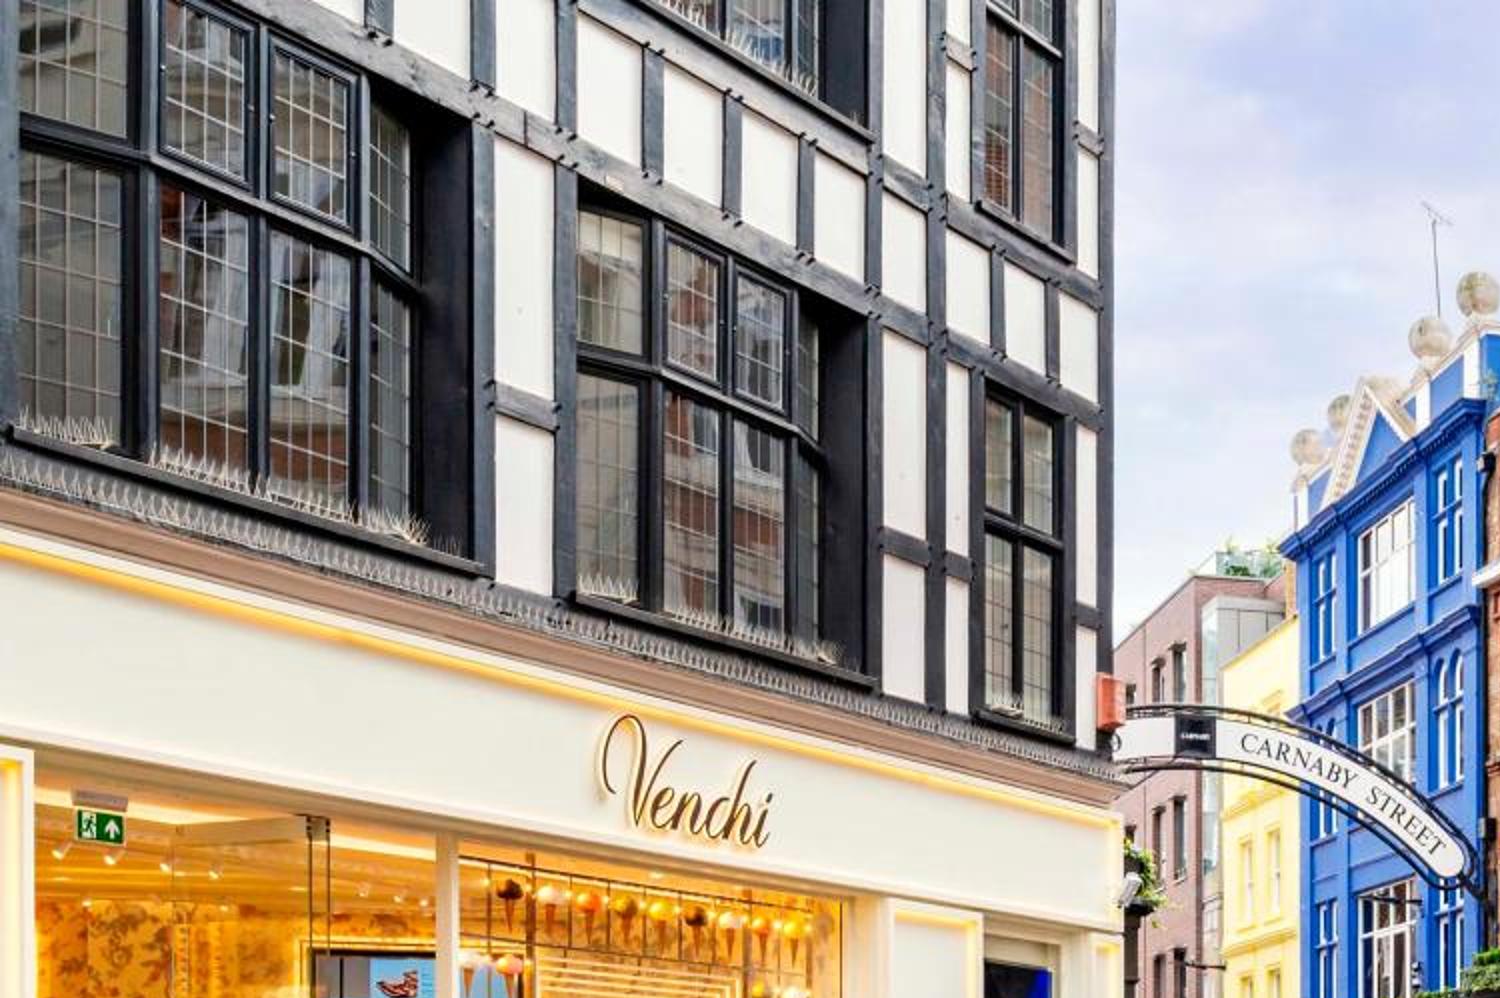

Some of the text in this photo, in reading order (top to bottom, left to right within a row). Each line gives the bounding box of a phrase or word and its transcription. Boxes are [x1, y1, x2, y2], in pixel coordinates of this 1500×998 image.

[602, 714, 773, 848] Venchi
[1241, 733, 1447, 855] CARNABY STREET
